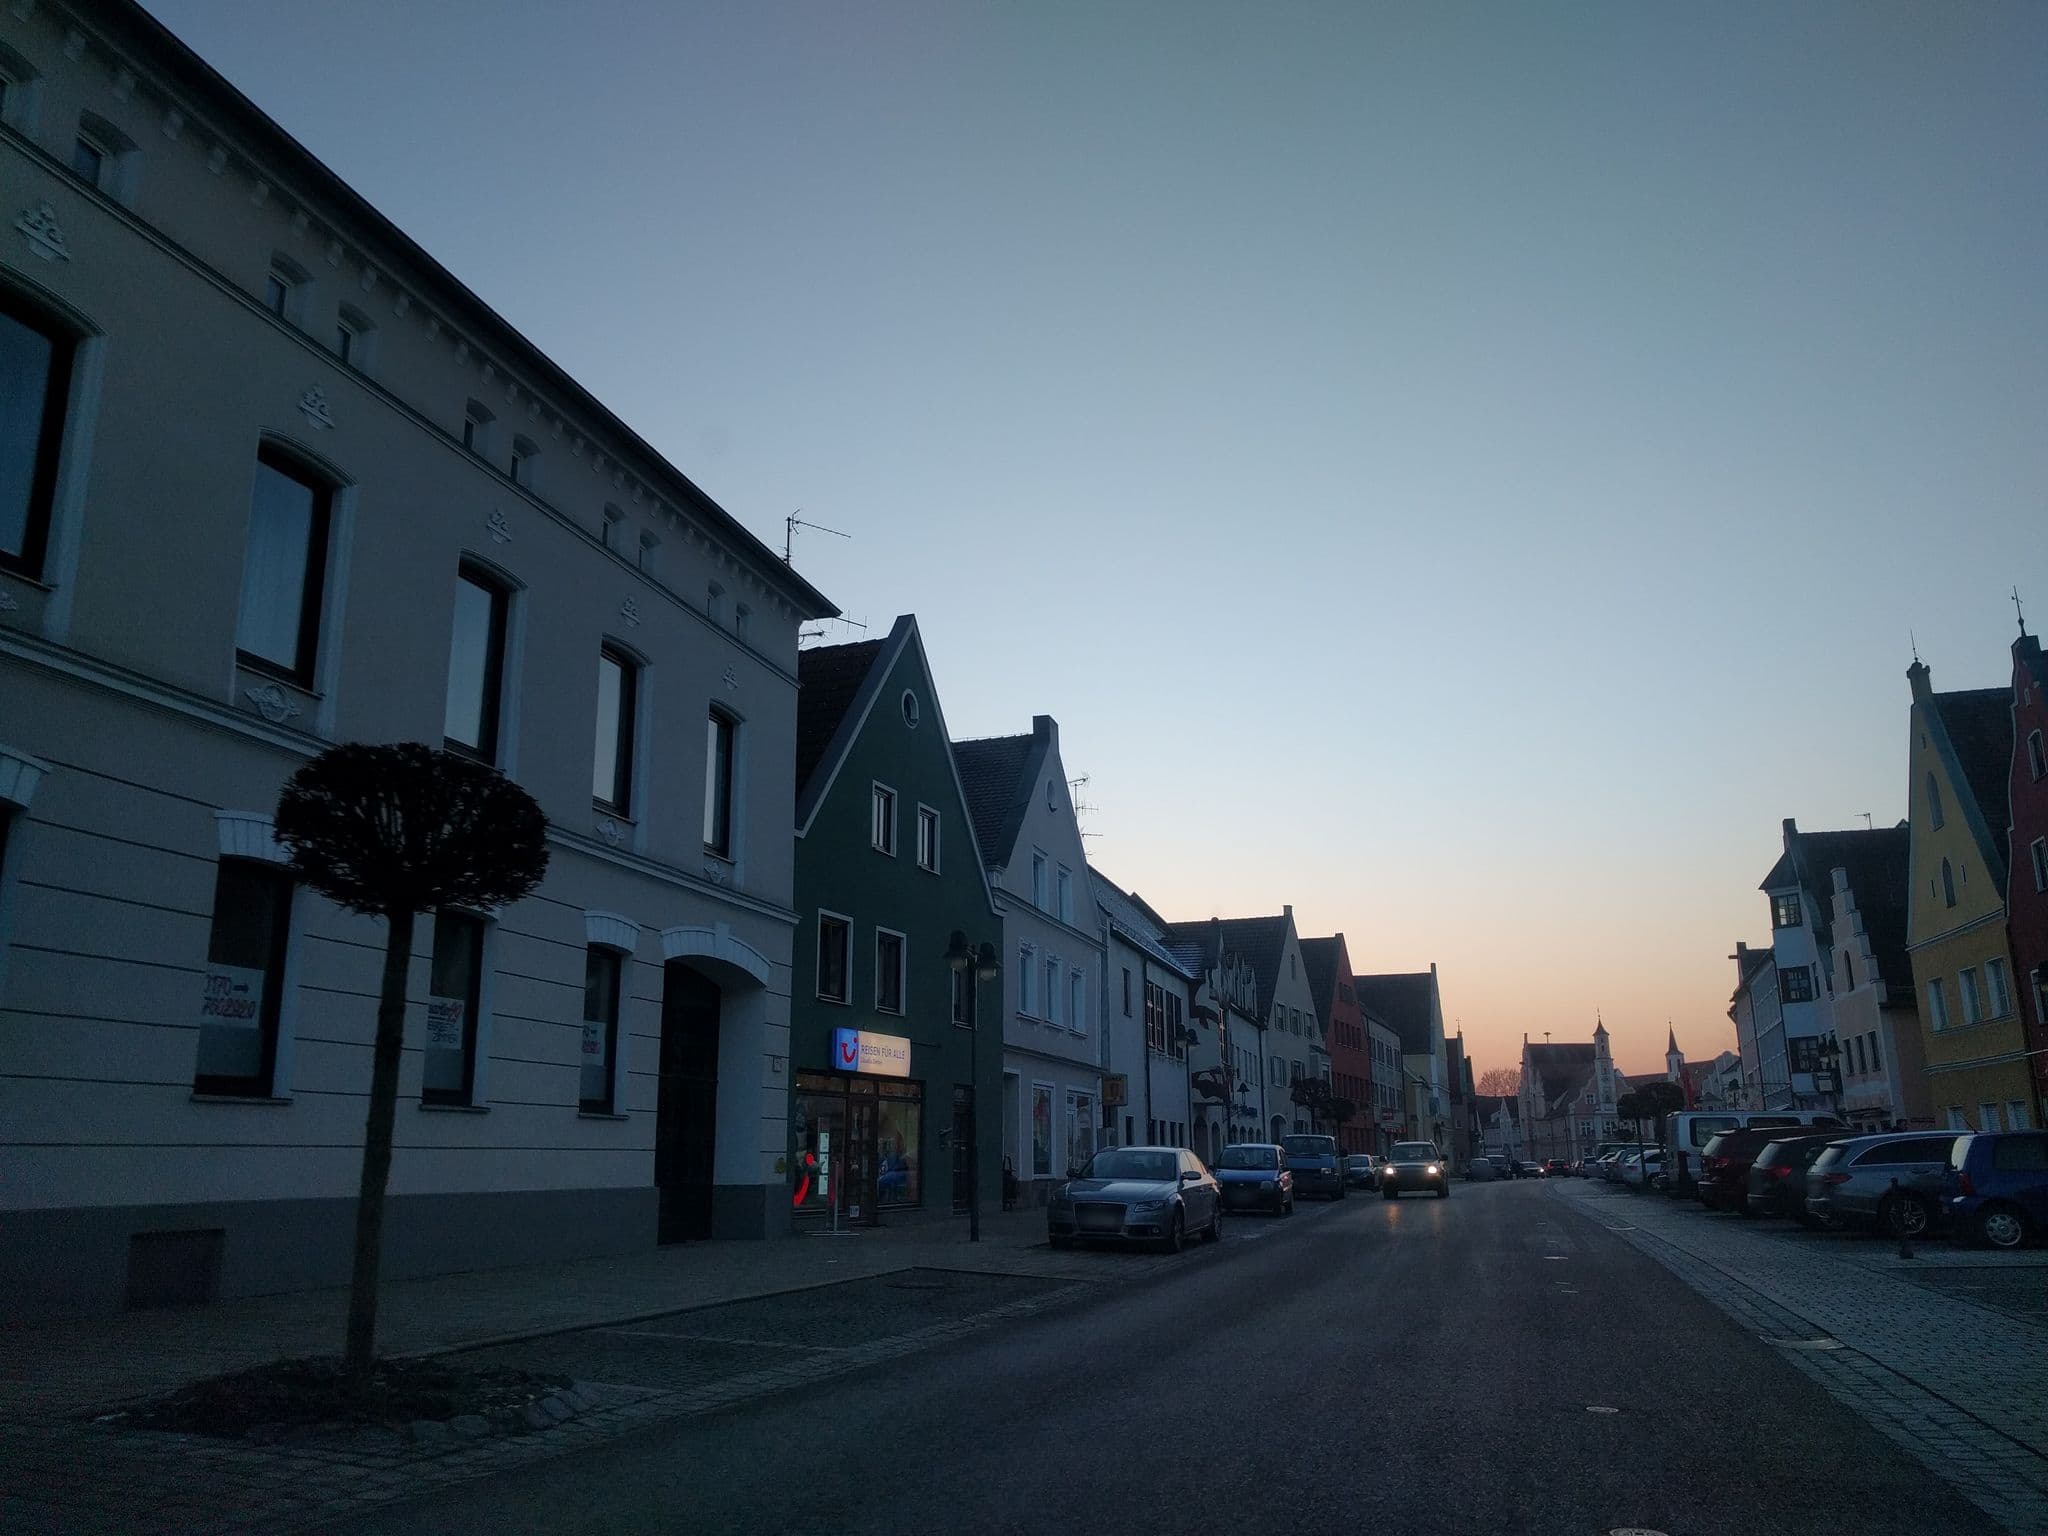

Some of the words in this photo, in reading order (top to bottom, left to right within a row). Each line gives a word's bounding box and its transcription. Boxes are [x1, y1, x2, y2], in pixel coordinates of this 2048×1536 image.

[861, 1044, 881, 1056] REISEN
[881, 1045, 892, 1058] FÜR
[892, 1048, 905, 1060] ALLE
